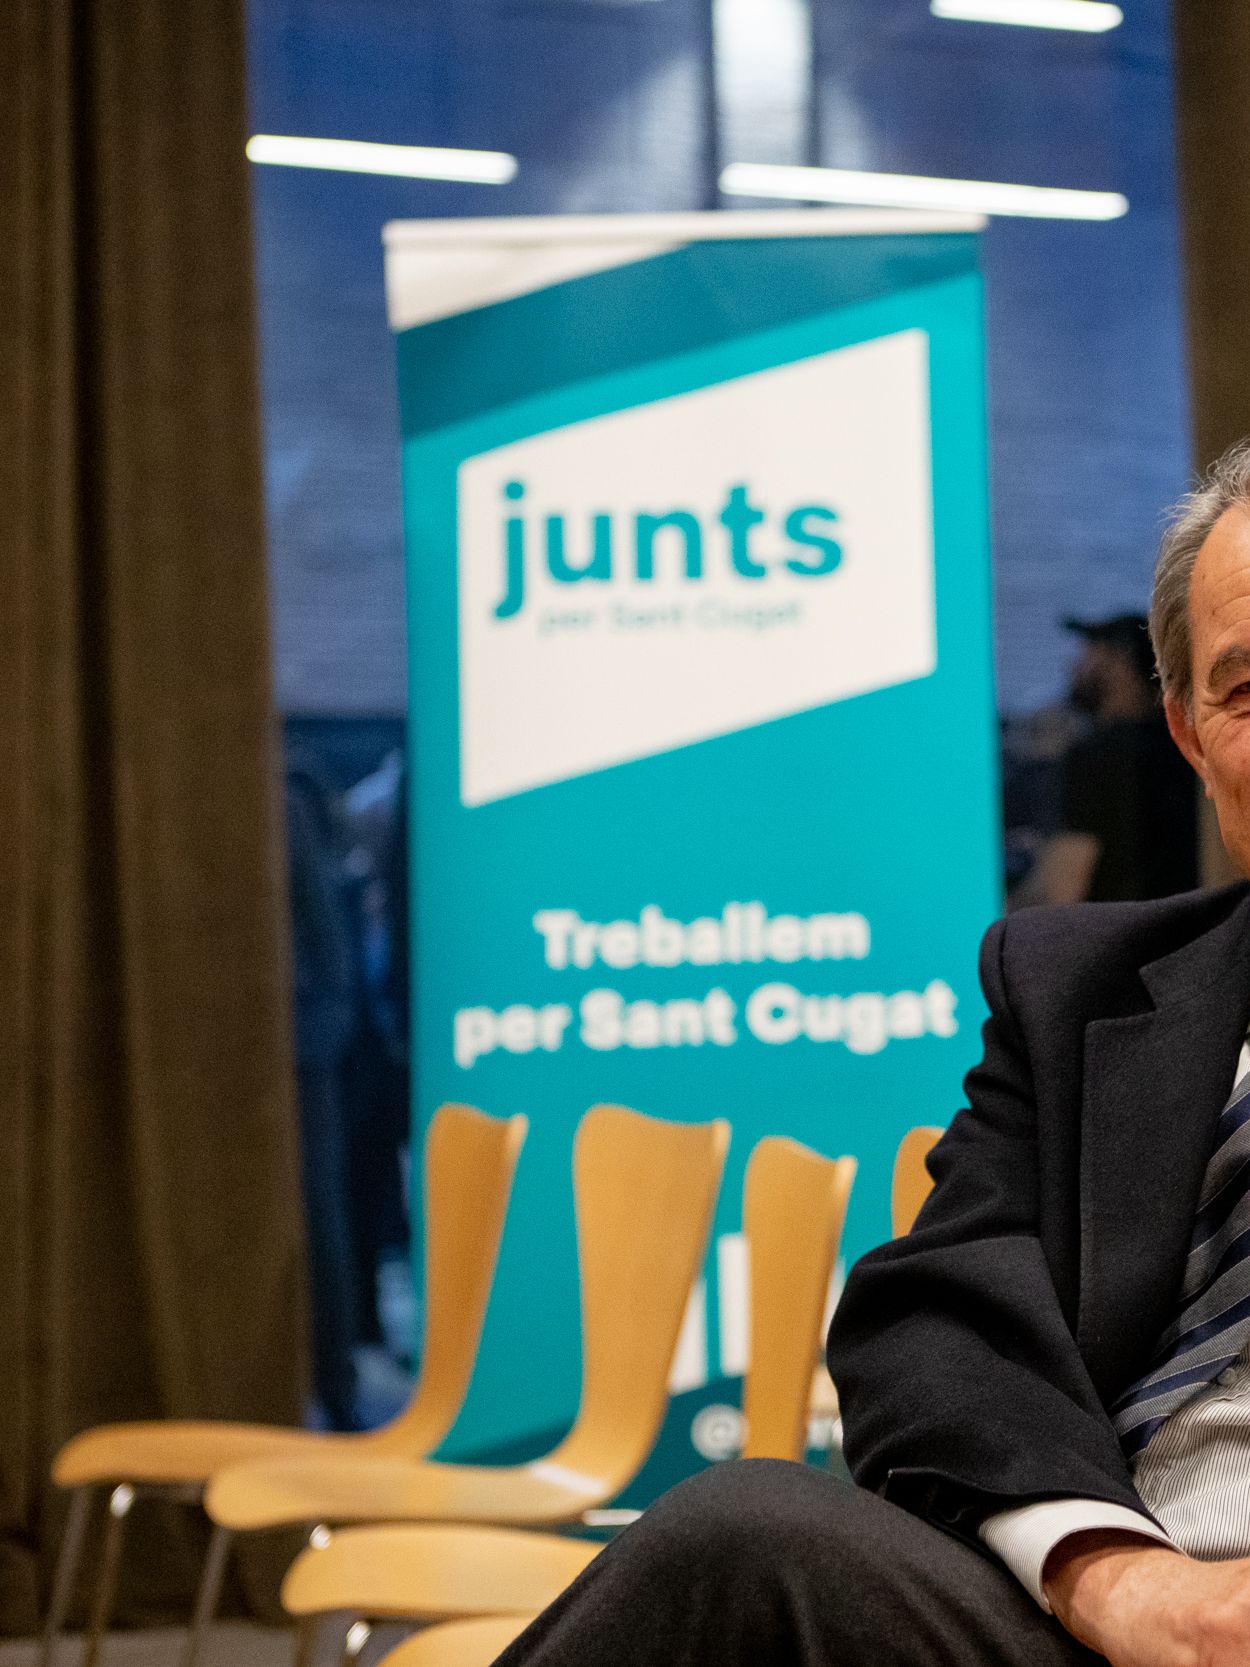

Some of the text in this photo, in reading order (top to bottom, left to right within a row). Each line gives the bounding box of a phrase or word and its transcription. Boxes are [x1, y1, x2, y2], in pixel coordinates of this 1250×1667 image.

[494, 480, 843, 620] junts
[610, 602, 682, 632] Sant
[532, 900, 872, 970] Treballem
[453, 978, 959, 1070] per Sant Cugat
